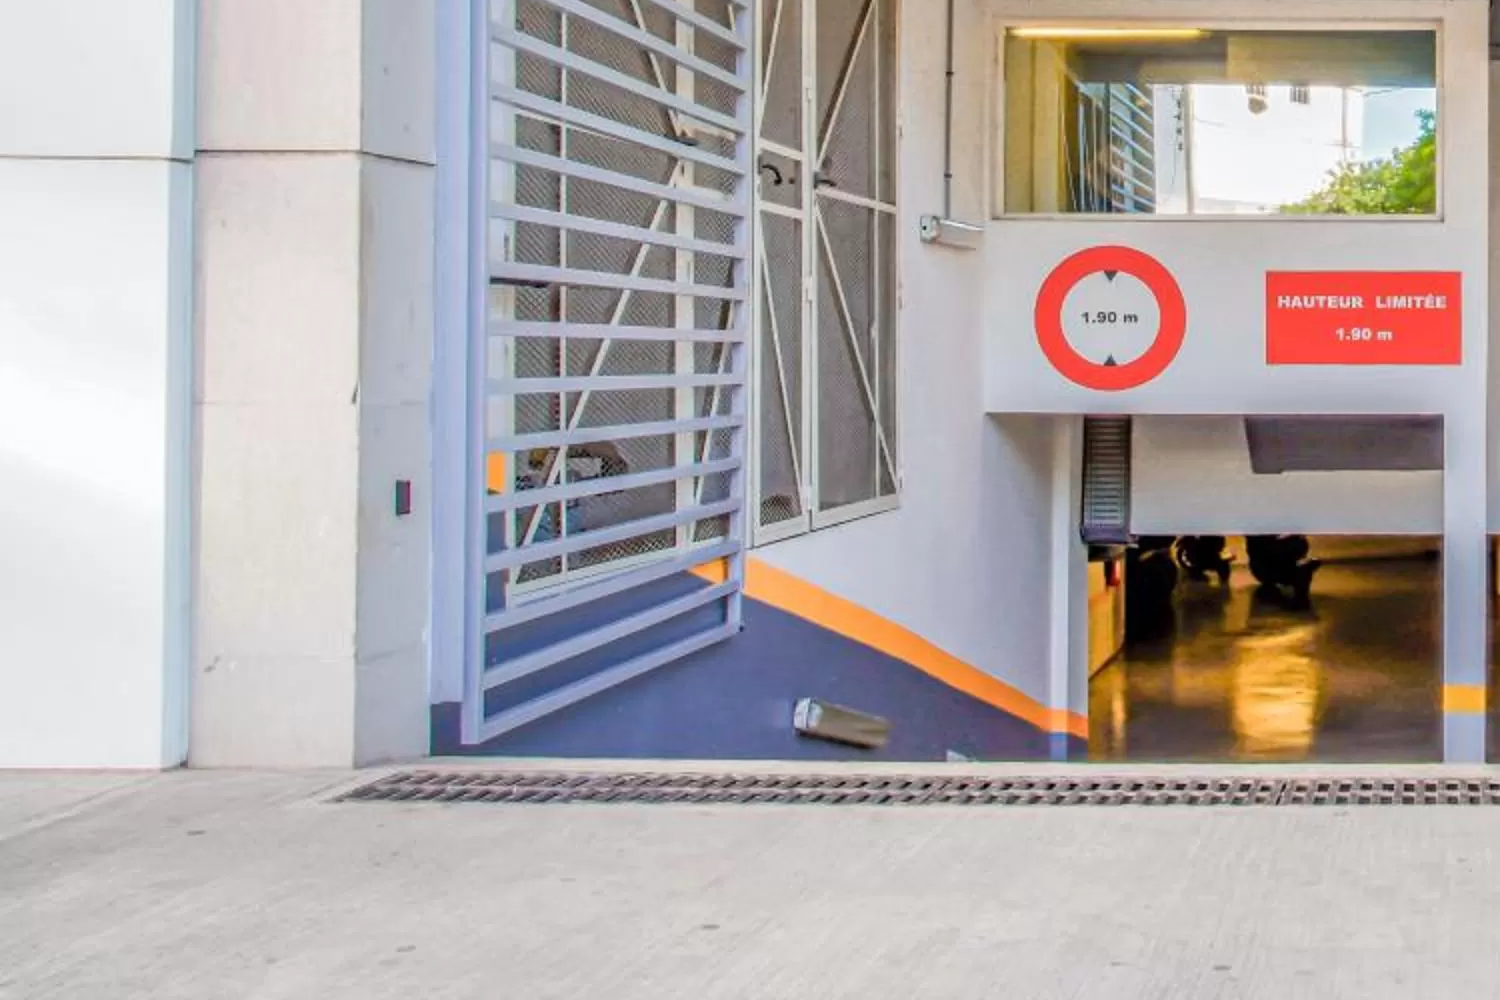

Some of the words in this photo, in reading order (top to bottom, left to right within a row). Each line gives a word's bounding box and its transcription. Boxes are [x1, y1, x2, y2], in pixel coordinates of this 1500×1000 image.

[1277, 295, 1364, 309] HAUTEUR
[1375, 292, 1447, 309] LIMITÉE
[1081, 311, 1118, 324] 1.90
[1123, 314, 1139, 324] m
[1335, 327, 1372, 341] 1.90
[1376, 330, 1393, 341] m
